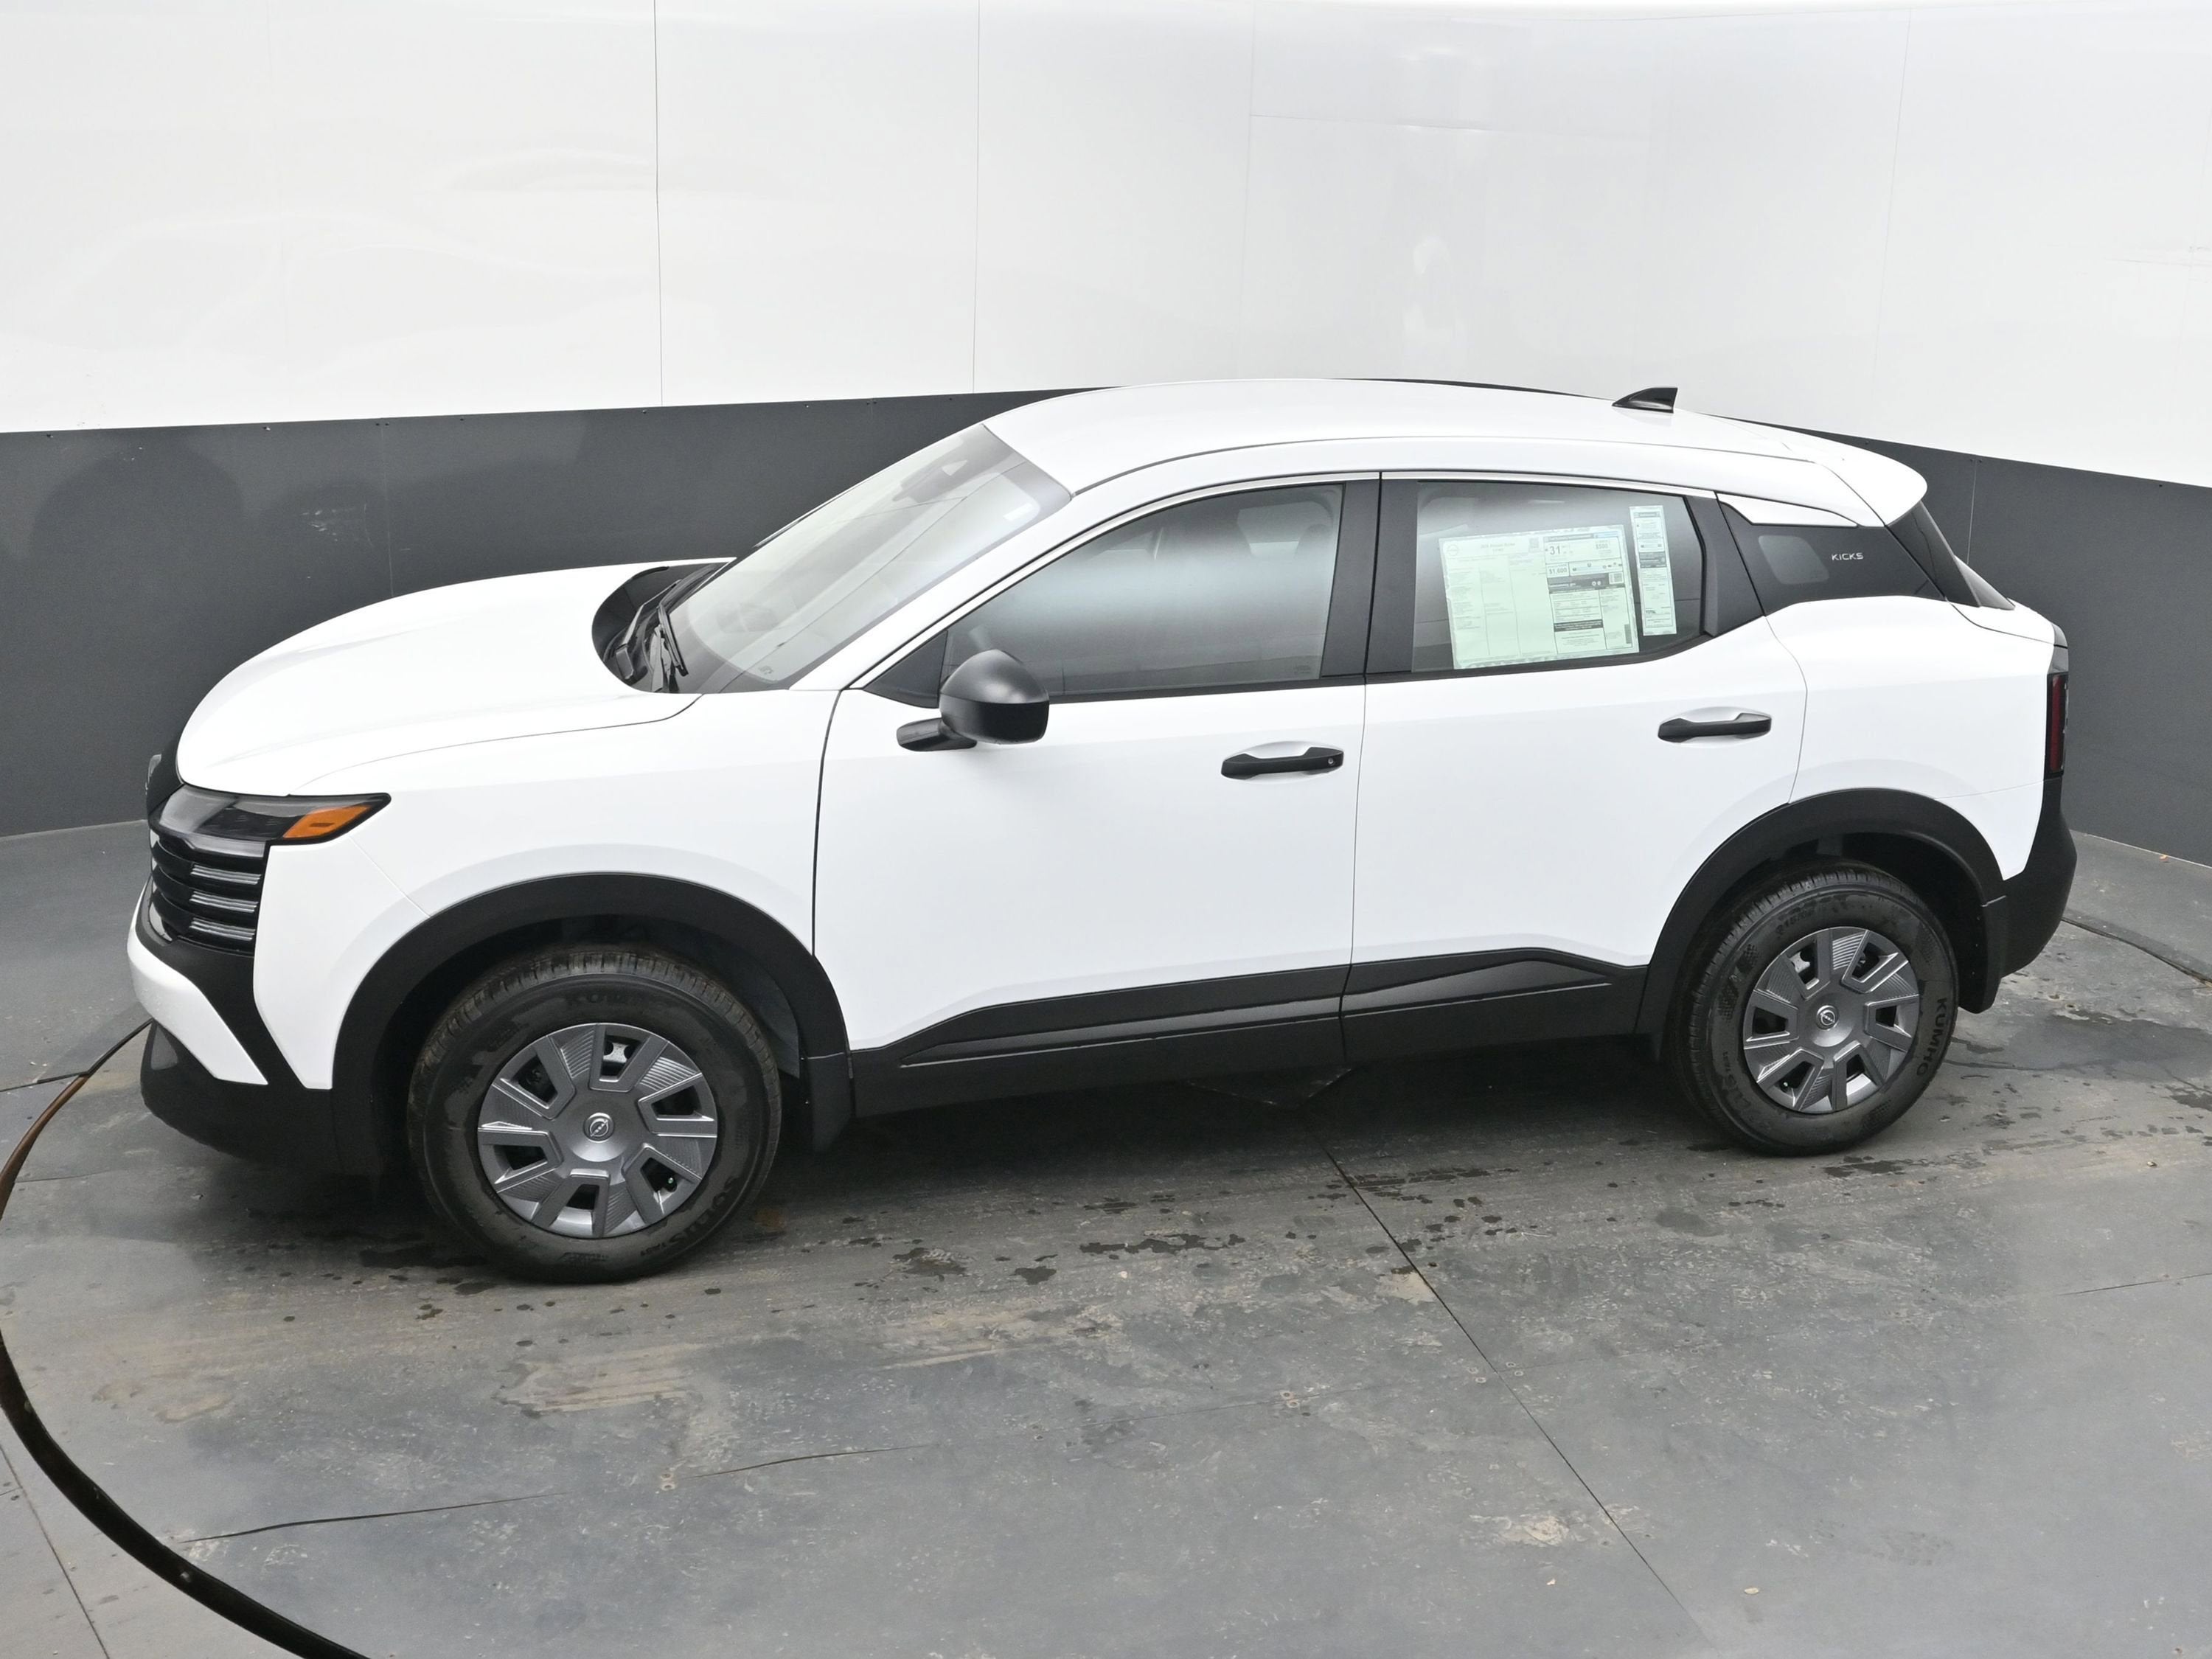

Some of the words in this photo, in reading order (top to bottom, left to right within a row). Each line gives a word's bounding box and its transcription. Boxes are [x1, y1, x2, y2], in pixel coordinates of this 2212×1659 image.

[1549, 546, 1561, 555] 31
[1832, 552, 1864, 561] KICKS
[1916, 998, 1947, 1076] KUMHO
